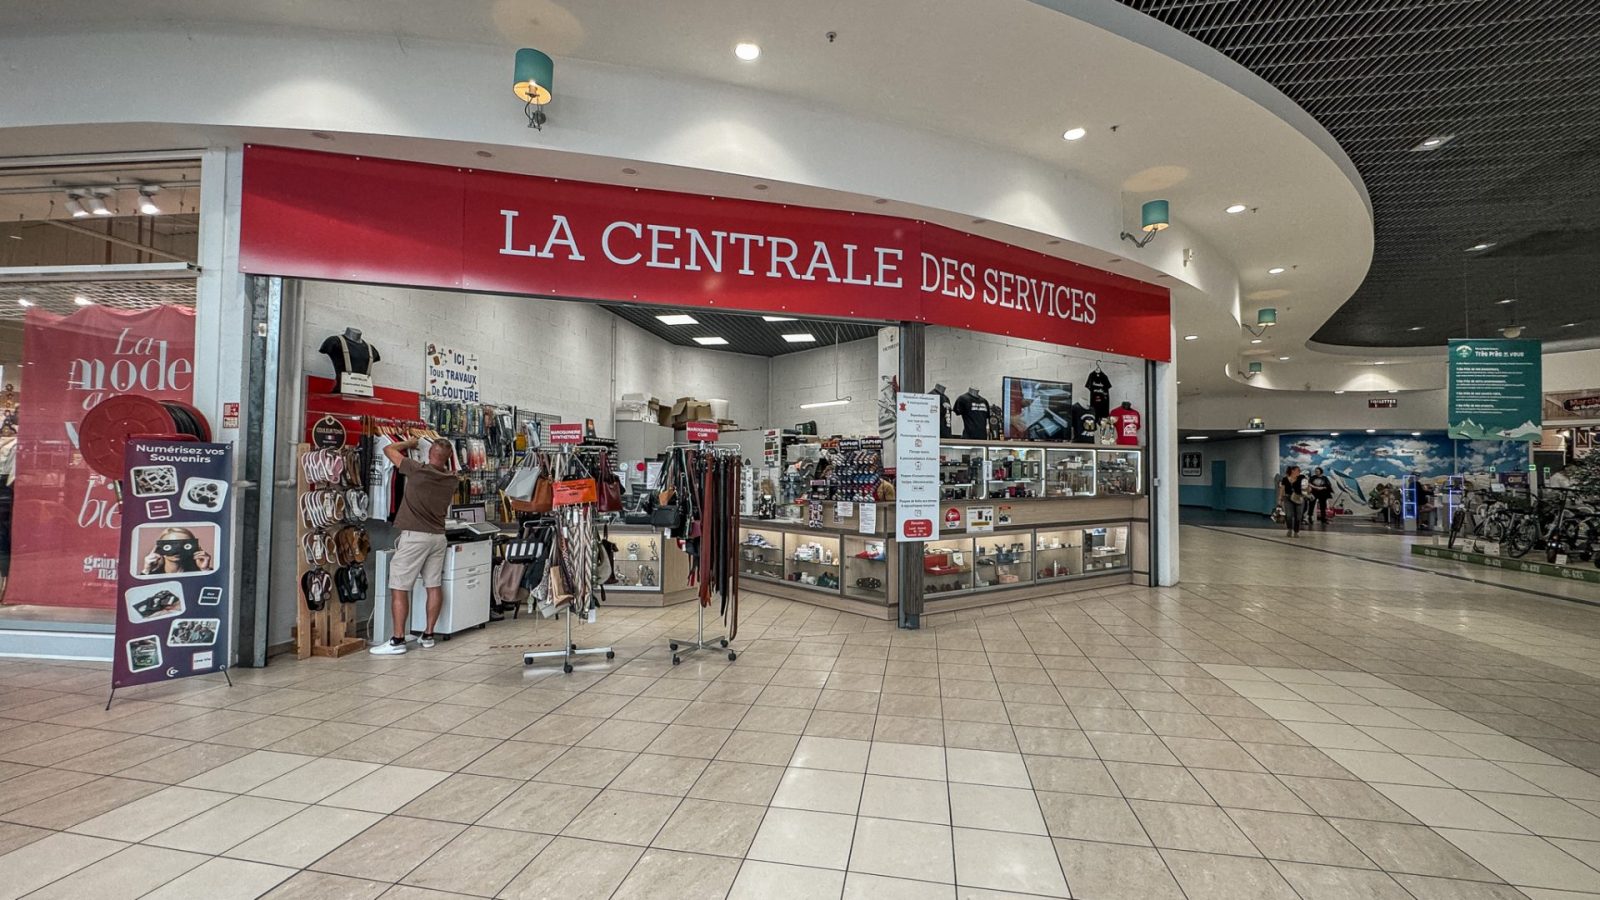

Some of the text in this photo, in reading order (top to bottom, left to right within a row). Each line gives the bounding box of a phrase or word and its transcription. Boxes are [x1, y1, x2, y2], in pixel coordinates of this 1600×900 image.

[499, 209, 1096, 325] LA CENTRALE DES SERVICES
[112, 327, 154, 356] La
[66, 340, 192, 392] mode
[454, 352, 465, 366] ICI
[430, 365, 477, 385] Tous TRAVAUX
[431, 385, 479, 402] De COUTURE
[135, 444, 203, 455] Numérisez
[149, 453, 211, 463] Souvenirs
